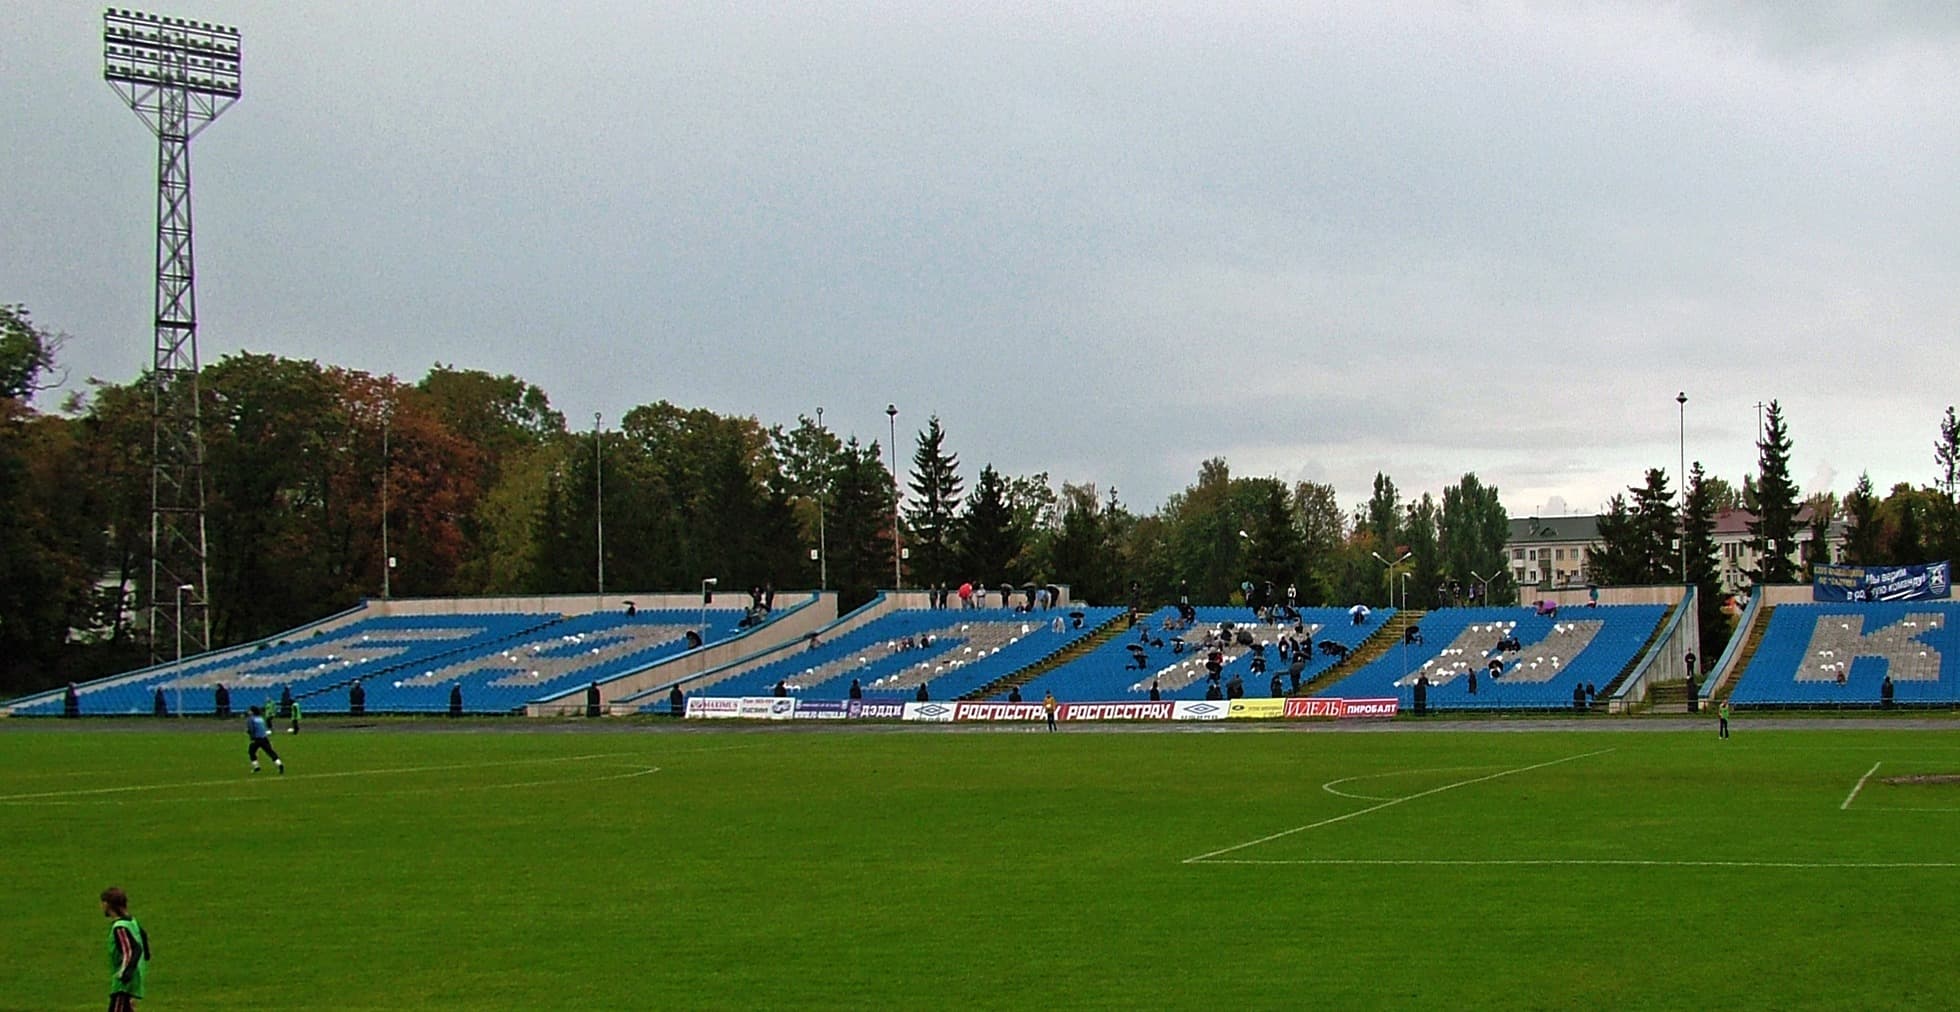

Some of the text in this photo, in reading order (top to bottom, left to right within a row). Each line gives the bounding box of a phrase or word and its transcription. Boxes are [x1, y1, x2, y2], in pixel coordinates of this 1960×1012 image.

[861, 704, 903, 717] ДЭДДИ
[1066, 703, 1171, 720] РОСГОССТРАХ
[1286, 701, 1339, 718] ИДЕЛЬ
[1347, 704, 1397, 714] ПИРОБАЛТ
